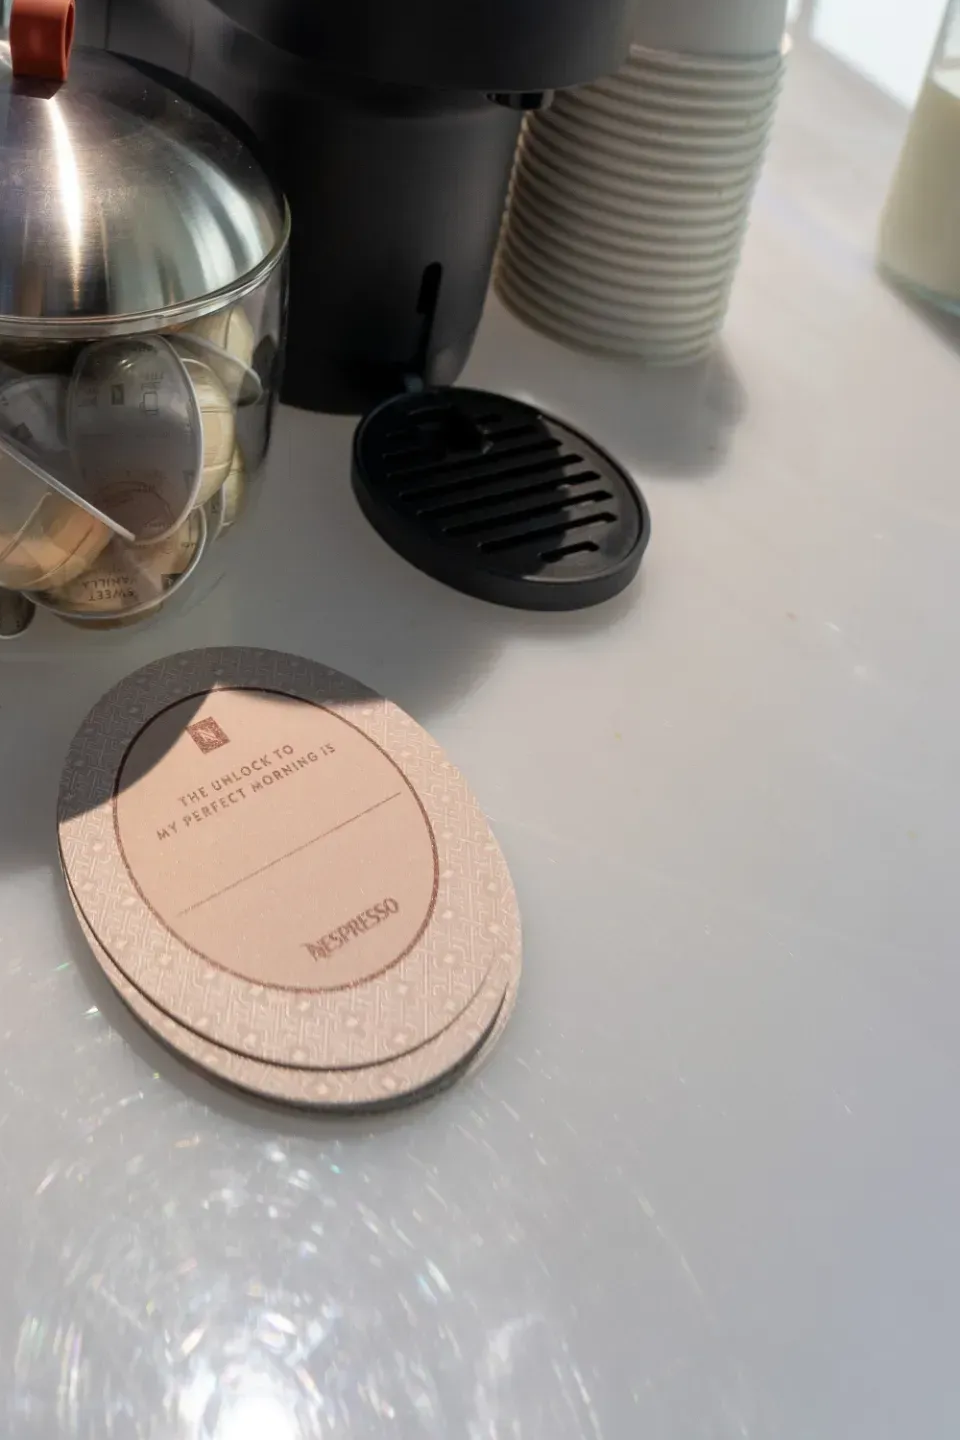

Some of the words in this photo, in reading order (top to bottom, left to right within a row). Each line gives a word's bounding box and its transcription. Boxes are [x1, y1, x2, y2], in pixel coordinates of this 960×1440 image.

[156, 821, 179, 841] MY
[182, 788, 247, 827] PERFECT
[250, 751, 319, 793] MORNING
[320, 742, 336, 756] IS
[178, 786, 209, 807] THE
[211, 754, 273, 791] UNLOCK
[273, 744, 294, 760] TO
[299, 897, 399, 962] NESPRESSO
